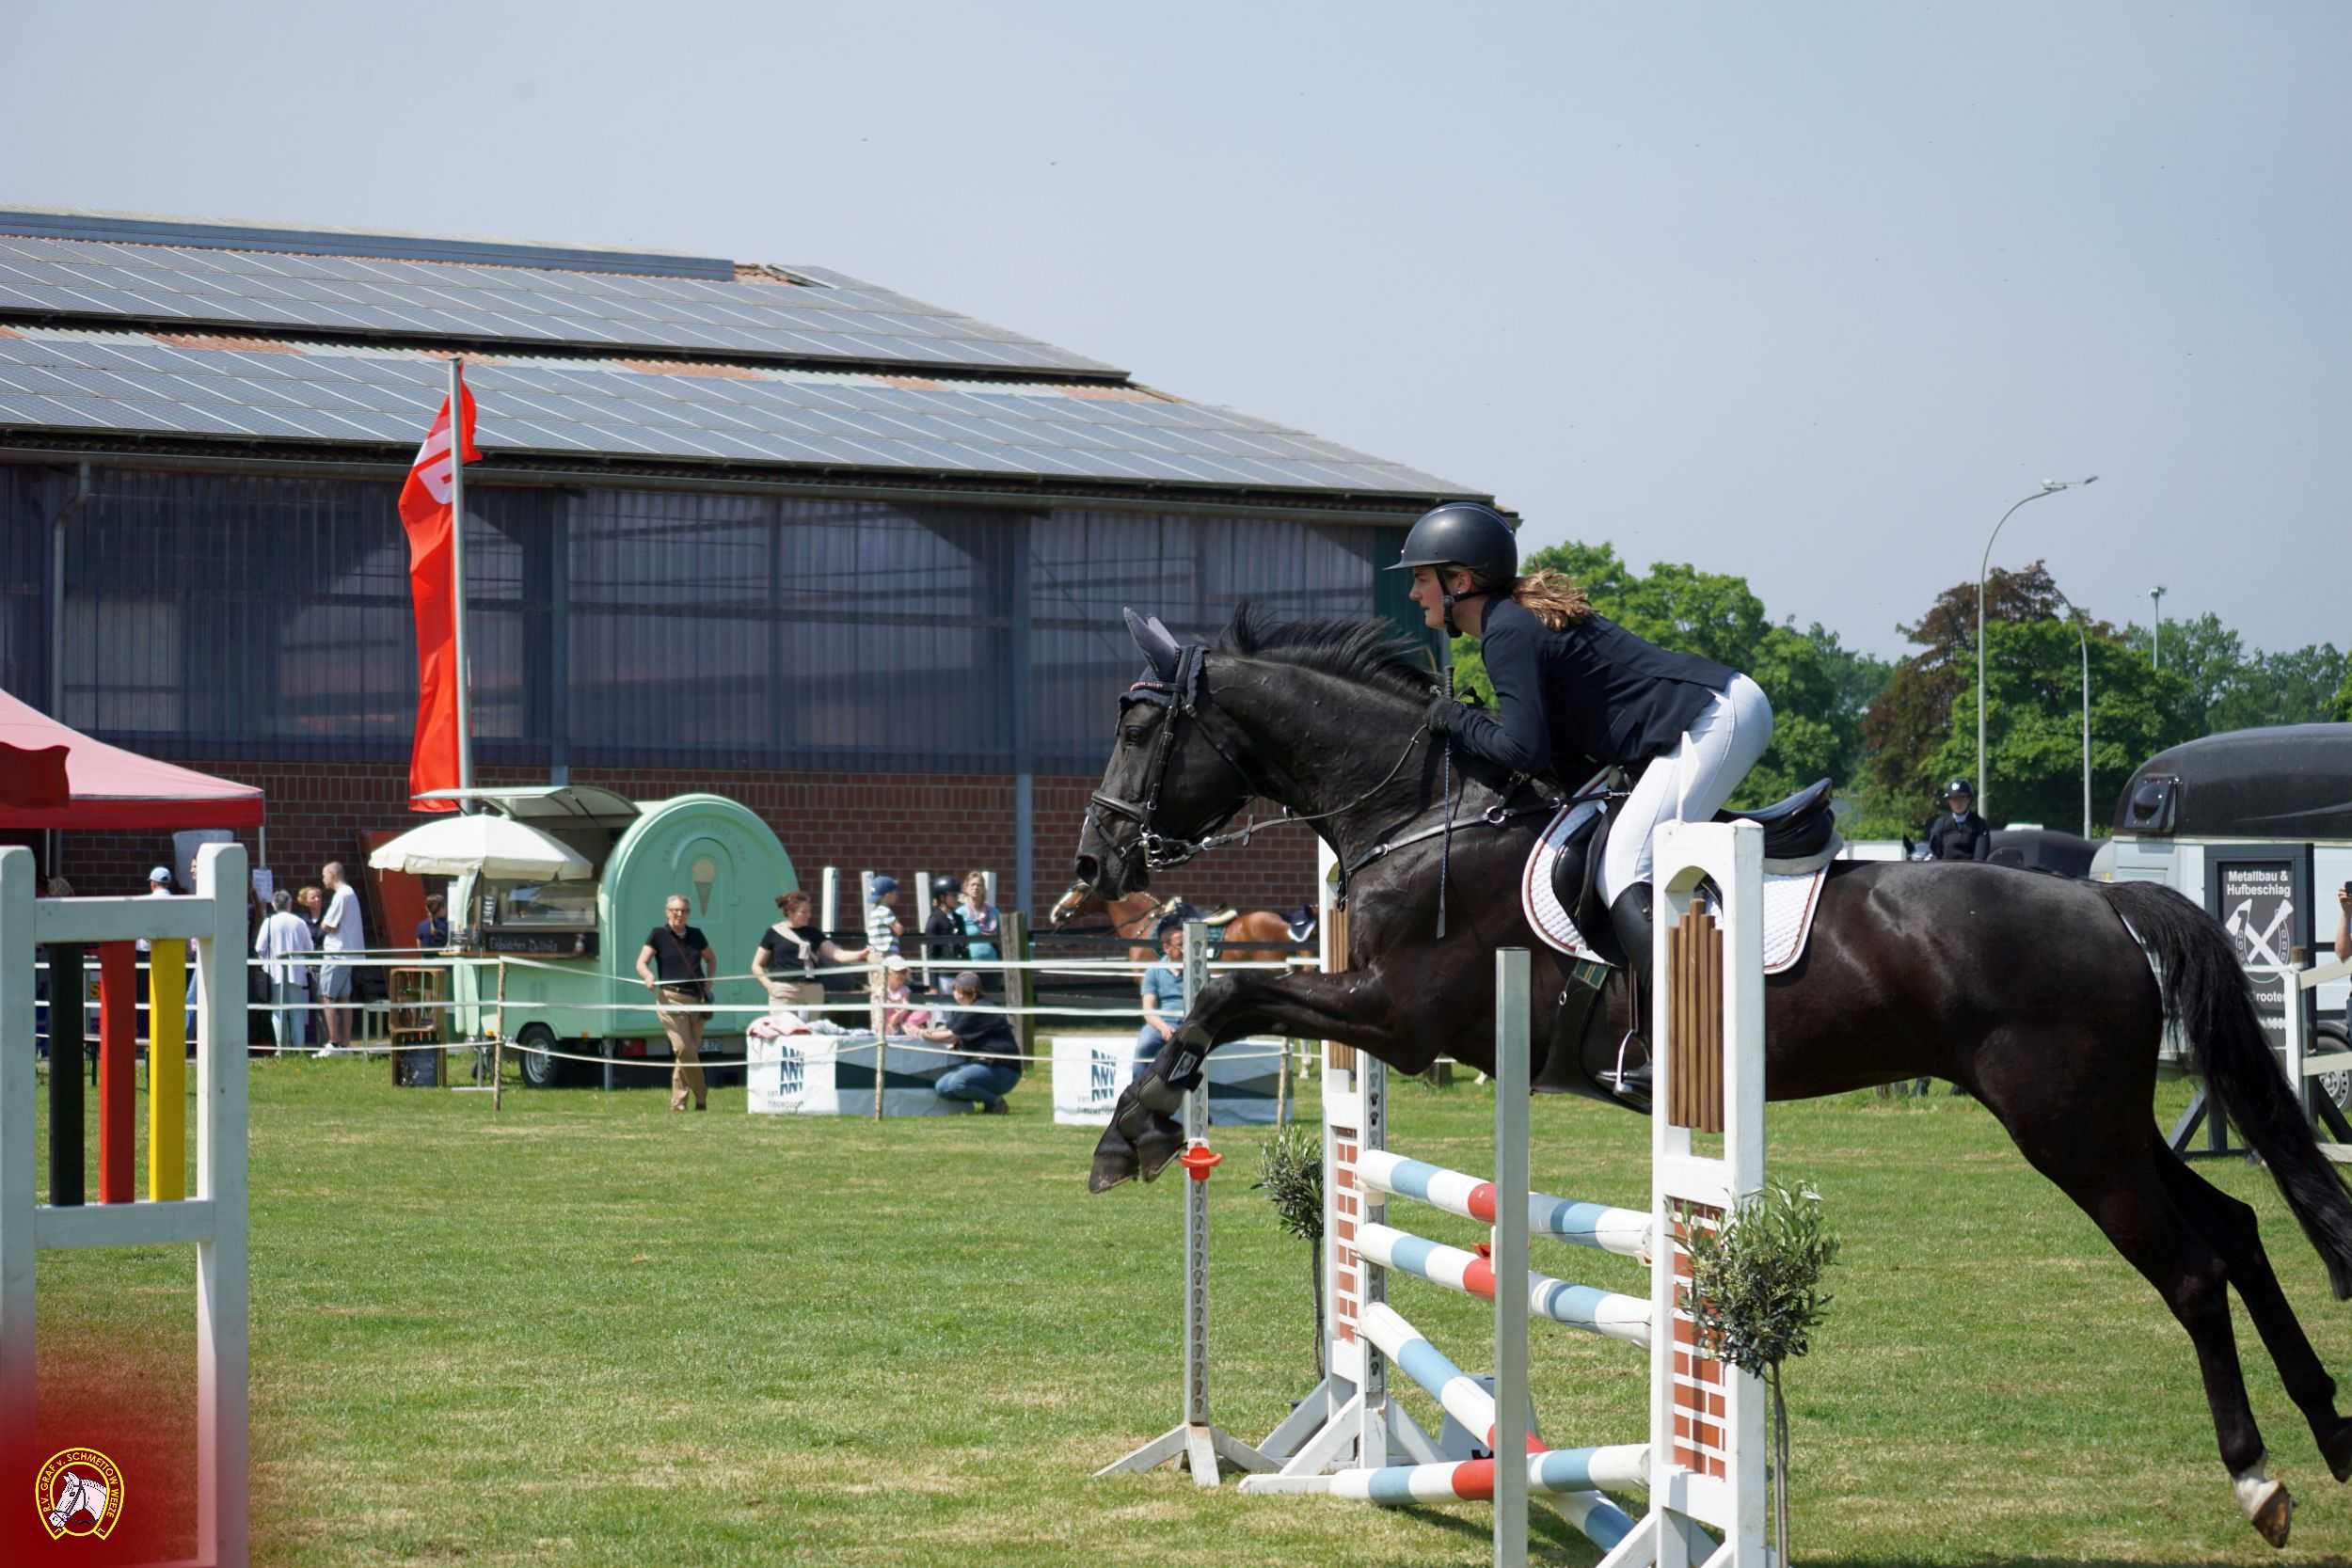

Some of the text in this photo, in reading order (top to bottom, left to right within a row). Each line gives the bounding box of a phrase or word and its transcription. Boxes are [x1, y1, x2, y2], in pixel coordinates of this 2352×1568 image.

[2228, 870, 2289, 882] Metallbau &
[2226, 883, 2291, 898] Hufbeschlag
